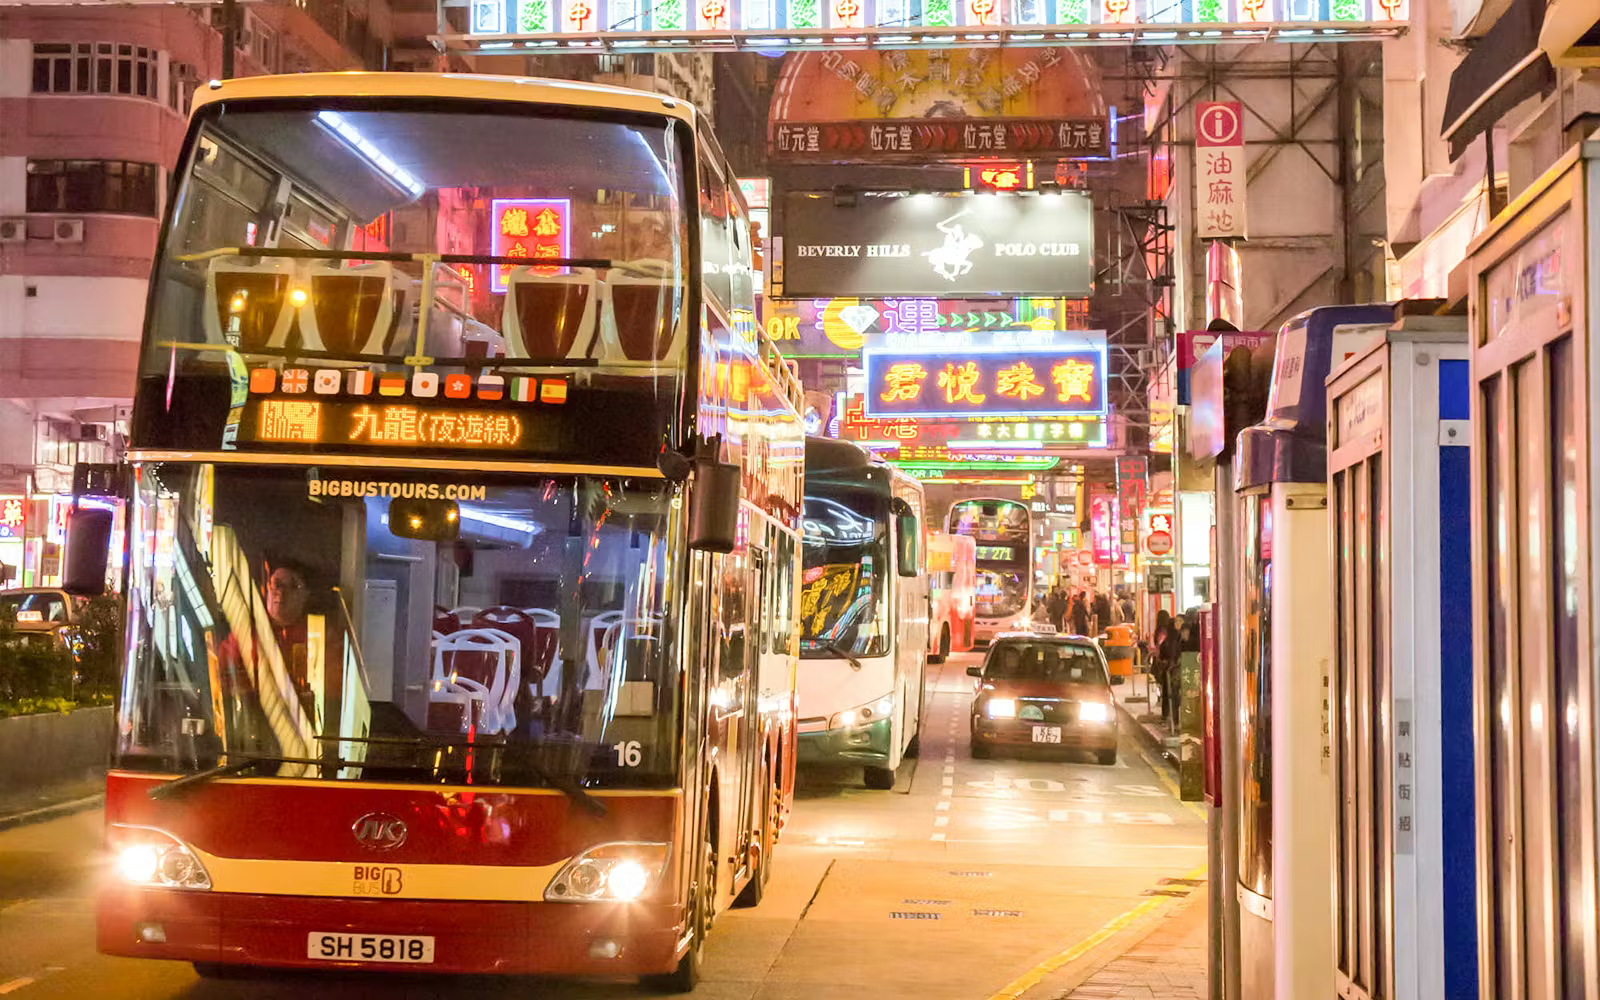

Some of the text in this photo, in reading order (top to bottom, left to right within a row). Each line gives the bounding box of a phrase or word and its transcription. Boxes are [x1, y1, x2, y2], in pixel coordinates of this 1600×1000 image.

[777, 122, 1102, 152] 位元堂 位元堂 位元堂 位元堂
[797, 242, 1080, 258] BEVERLY HILLS POLO CLUB
[308, 479, 486, 502] BIGBUSTOURS.COM
[991, 546, 1012, 561] 271
[613, 740, 642, 768] 16
[354, 865, 381, 881] BIG
[320, 935, 425, 961] SH 5818
